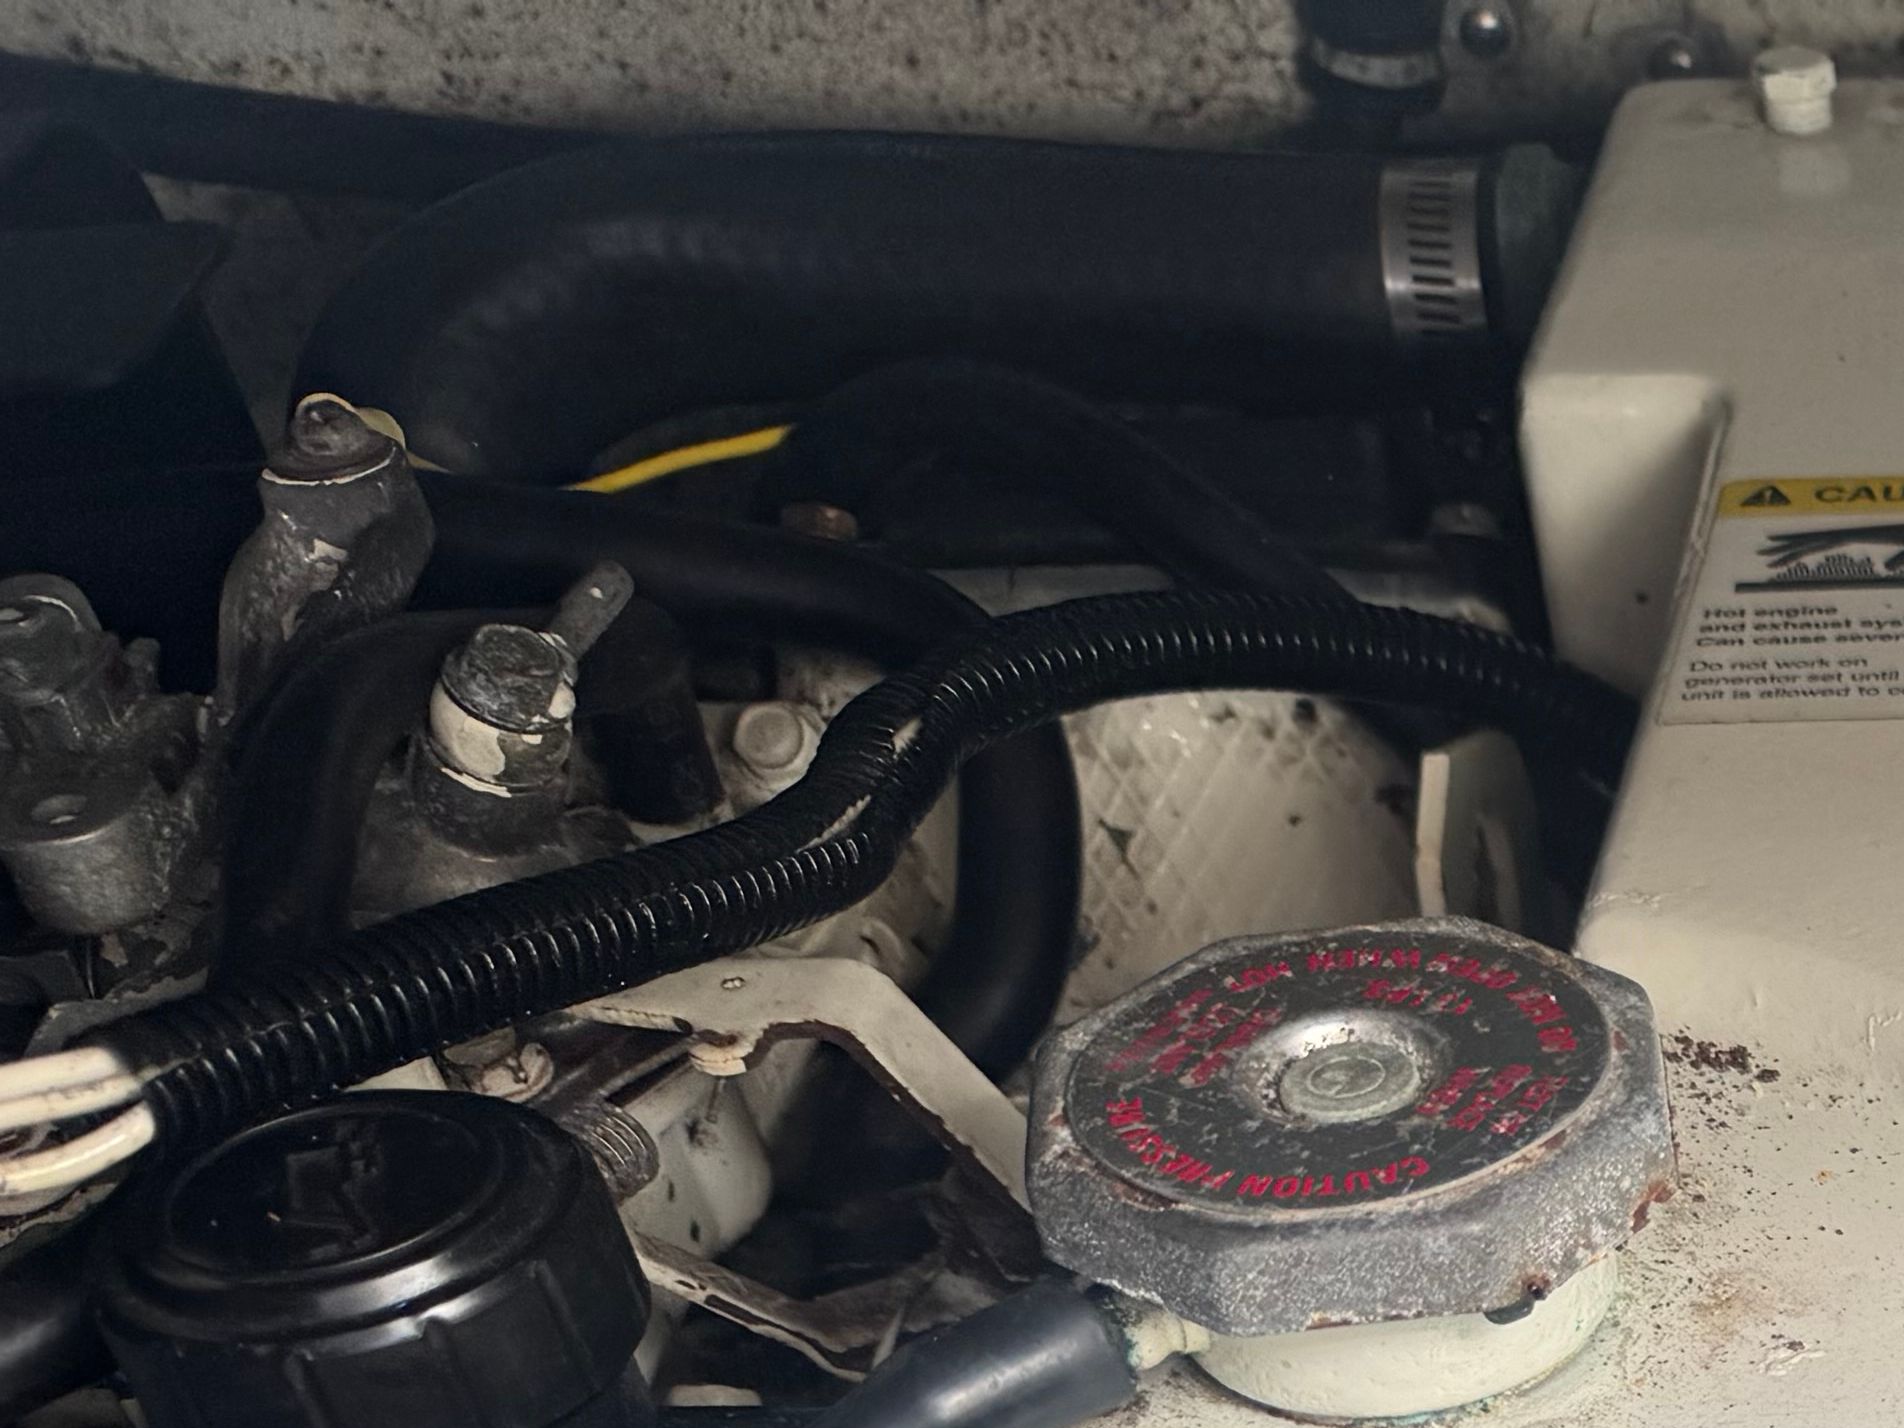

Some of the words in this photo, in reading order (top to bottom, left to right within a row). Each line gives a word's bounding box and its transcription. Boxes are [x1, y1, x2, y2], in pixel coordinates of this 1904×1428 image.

[1703, 606, 1746, 619] Hot
[1754, 606, 1838, 621] engine
[1699, 622, 1746, 634] and
[1753, 620, 1851, 633] exhaust
[1696, 636, 1745, 647] Can
[1753, 636, 1827, 646] cause
[1689, 660, 1723, 672] Do
[1730, 660, 1768, 671] not
[1775, 658, 1830, 669] work
[1838, 658, 1869, 668] on
[1685, 674, 1801, 689] generator
[1806, 673, 1843, 684] set
[1850, 671, 1900, 683] until
[1681, 689, 1725, 701] unit
[1732, 689, 1751, 700] is
[1759, 687, 1851, 699] allowed
[1858, 686, 1880, 697] to
[1237, 1156, 1431, 1198] CAUTION
